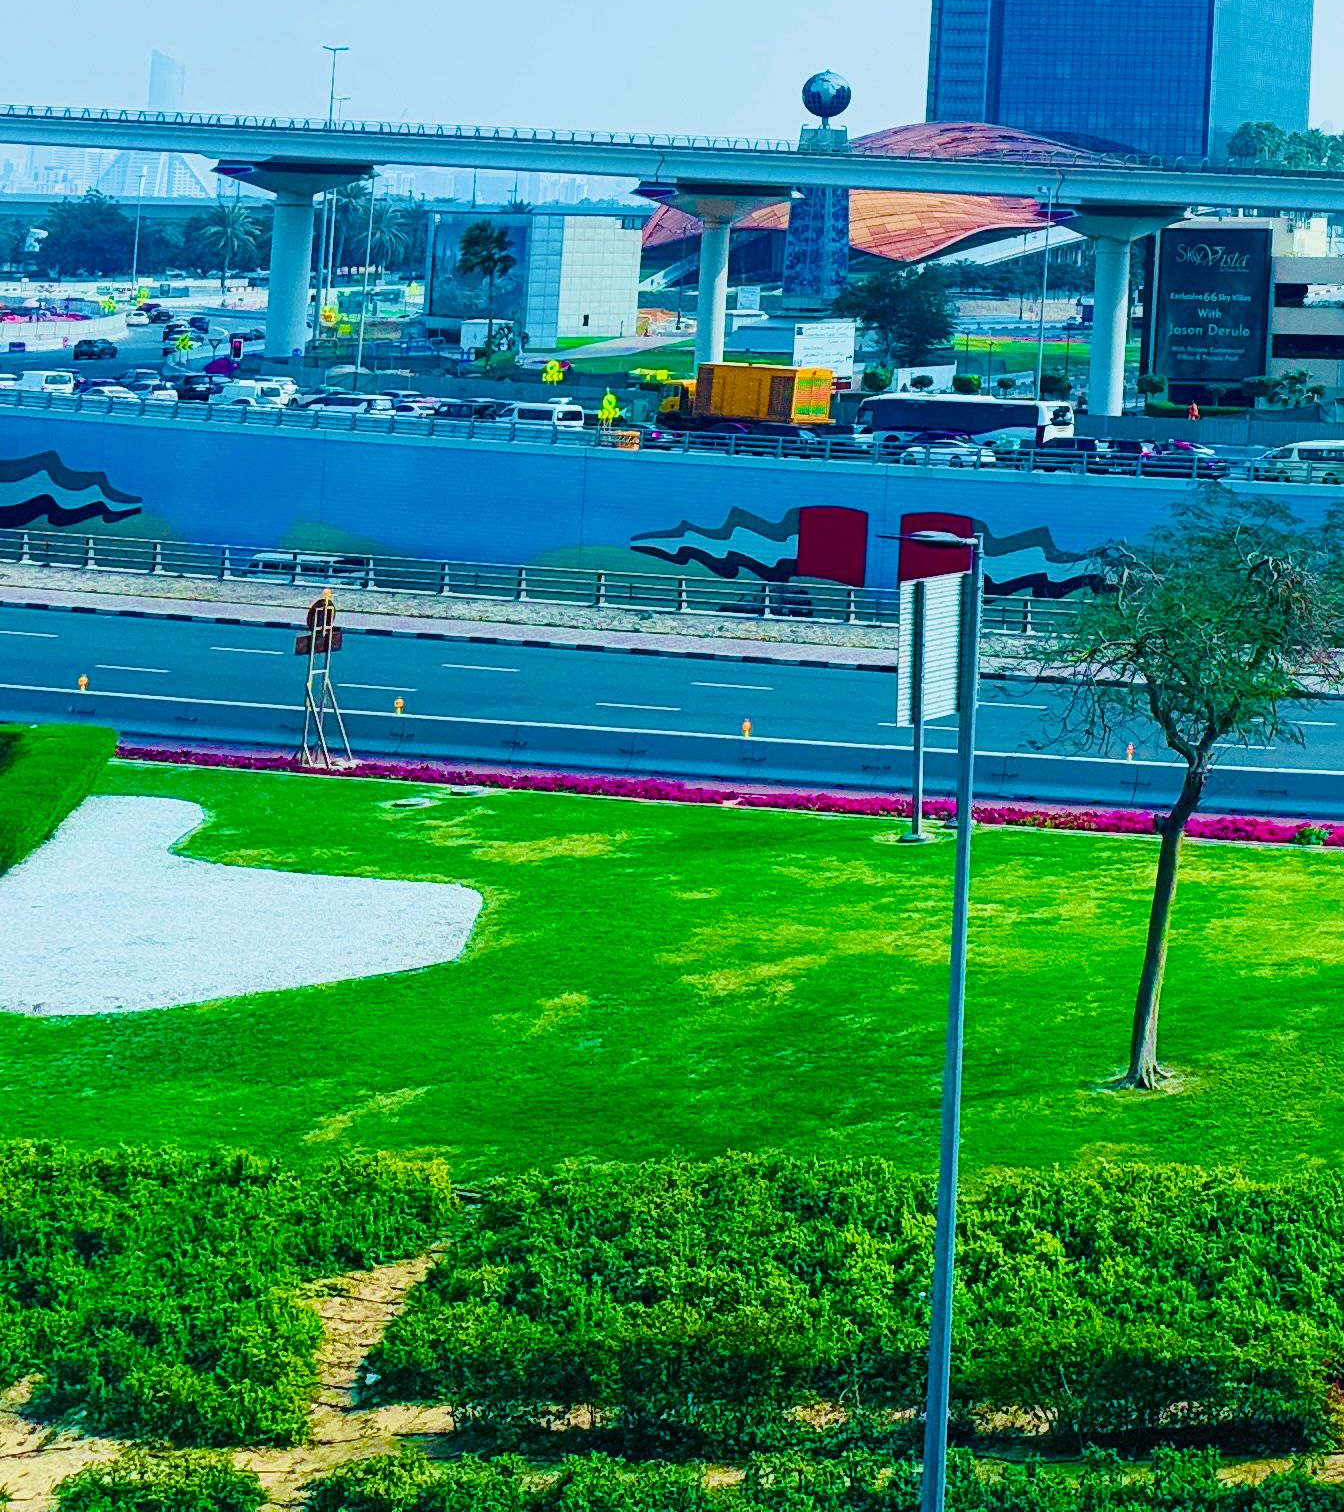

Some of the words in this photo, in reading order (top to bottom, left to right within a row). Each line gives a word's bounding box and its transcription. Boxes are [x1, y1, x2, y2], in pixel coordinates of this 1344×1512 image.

[1198, 308, 1222, 319] With
[1167, 323, 1203, 337] Jason
[1208, 323, 1250, 337] Derulo
